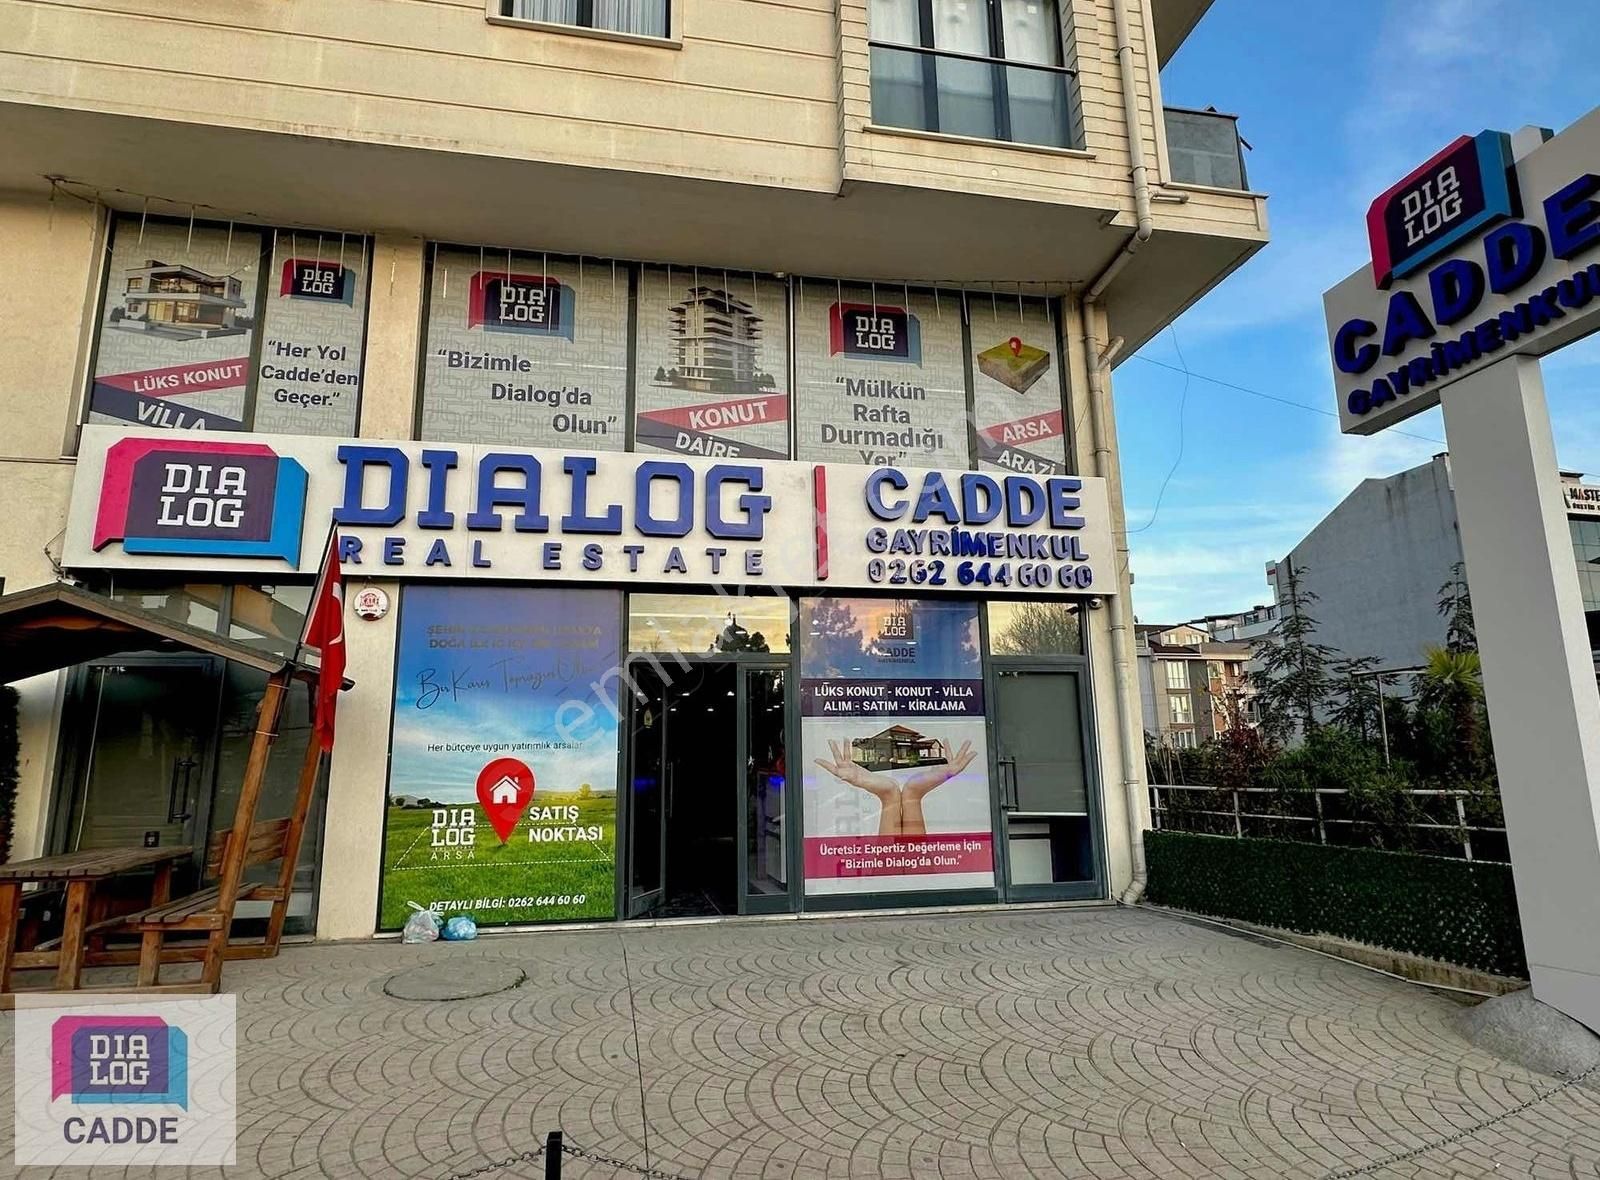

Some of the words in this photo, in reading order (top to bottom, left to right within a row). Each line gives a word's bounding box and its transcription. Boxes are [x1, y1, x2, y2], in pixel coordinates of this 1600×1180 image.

[1401, 166, 1461, 221] DIA
[1404, 191, 1463, 247] LOG
[302, 268, 335, 283] DIA
[1334, 173, 1600, 374] CADDE
[301, 281, 334, 295] LOG
[500, 286, 545, 306] DIA
[499, 304, 545, 323] LOG
[855, 316, 896, 335] DIA
[856, 333, 896, 350] LOG
[318, 344, 347, 362] Yol
[133, 374, 180, 393] LÜKS
[183, 365, 242, 385] KONUT
[688, 401, 768, 429] KONUT
[853, 403, 911, 425] Rafta
[821, 424, 943, 453] Durmadığı
[1003, 420, 1052, 443] ARSA
[161, 463, 248, 497] DIA
[332, 445, 772, 540] DIALOG
[865, 467, 1085, 530] CADDE
[156, 496, 246, 528] LOG
[865, 526, 1089, 561] GAYRİMENKUL
[339, 535, 491, 568] REAL
[543, 542, 764, 575] ESTATE
[867, 557, 947, 587] 0262
[883, 616, 906, 626] DIA
[884, 626, 907, 636] LOG
[815, 682, 844, 697] LÜKS
[846, 686, 885, 697] KONUT
[895, 686, 933, 697] KONUT
[942, 684, 973, 697] VİLLA
[824, 700, 852, 711] ALIM
[863, 700, 898, 711] SATIM
[908, 698, 966, 711] KİRALAMA
[428, 743, 444, 752] Her
[446, 742, 481, 753] bütçeye
[483, 743, 509, 753] uygun
[432, 808, 476, 827] DIA
[529, 805, 579, 823] SATIŞ
[431, 827, 476, 847] LOG
[528, 826, 603, 843] NOKTASI
[430, 850, 475, 861] ARSA
[819, 843, 862, 856] Ücretsiz
[864, 843, 905, 856] Expertiz
[907, 841, 961, 855] Değerleme
[963, 839, 982, 852] İçin
[429, 900, 474, 912] DETAYLI
[475, 897, 505, 910] BİLGİ:
[508, 897, 533, 908] 0262
[536, 896, 555, 907] 644
[557, 895, 570, 905] 60
[572, 894, 586, 905] 60
